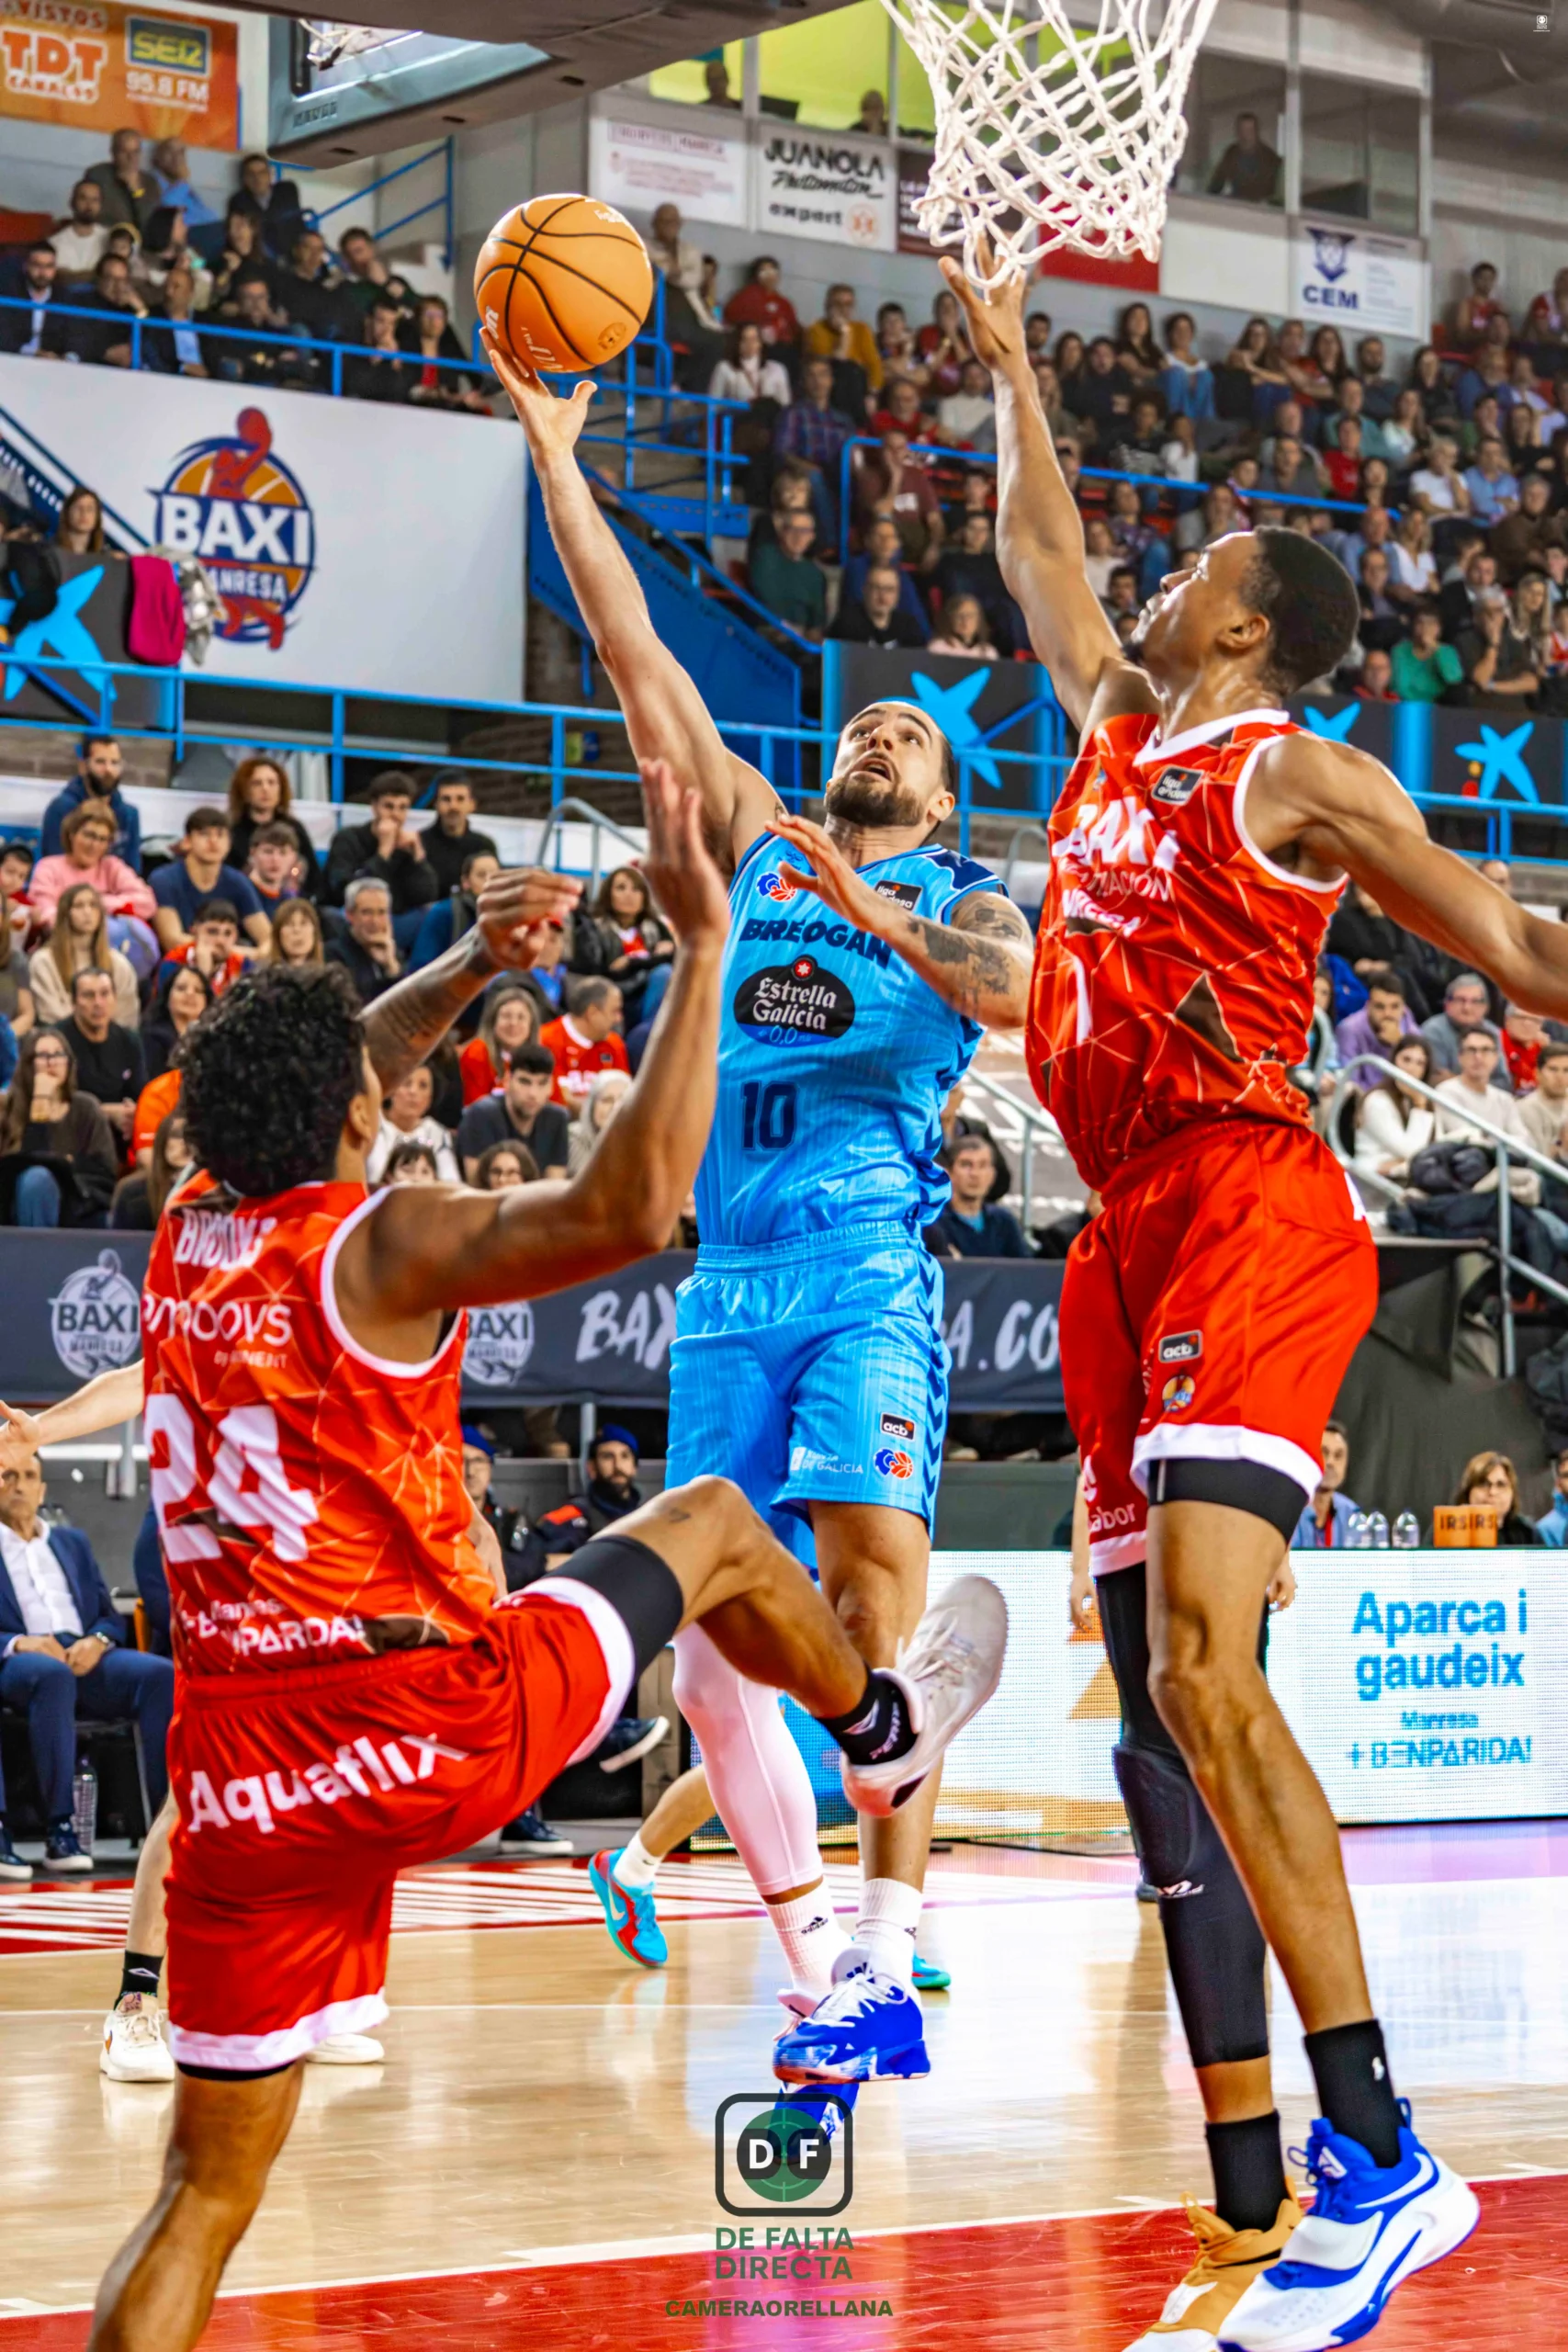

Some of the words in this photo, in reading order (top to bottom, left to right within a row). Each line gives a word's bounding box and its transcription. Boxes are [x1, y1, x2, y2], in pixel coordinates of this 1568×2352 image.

[3, 29, 104, 81] TDT
[133, 31, 203, 68] SER
[127, 70, 174, 96] 95.8
[176, 79, 209, 102] FM
[764, 138, 885, 182] JUANOLA
[1303, 284, 1359, 311] CEM
[162, 494, 310, 564] BAXI
[206, 565, 287, 602] ANRESA
[876, 885, 897, 898] liga
[739, 918, 893, 965] BREOGAN
[754, 977, 838, 1010] Estrella
[752, 998, 828, 1031] Galicia
[740, 1080, 801, 1152] 10
[57, 1304, 140, 1333] BAXI
[940, 1299, 1059, 1372] A.CO
[1163, 1342, 1192, 1359] acb
[883, 1420, 908, 1437] acb
[143, 1393, 319, 1563] 24
[817, 1463, 864, 1475] GALICIA
[1351, 1590, 1506, 1648] Aparca
[1517, 1588, 1527, 1634] i
[1356, 1642, 1525, 1701] gaudeix
[186, 1733, 470, 1834] Aquaflix
